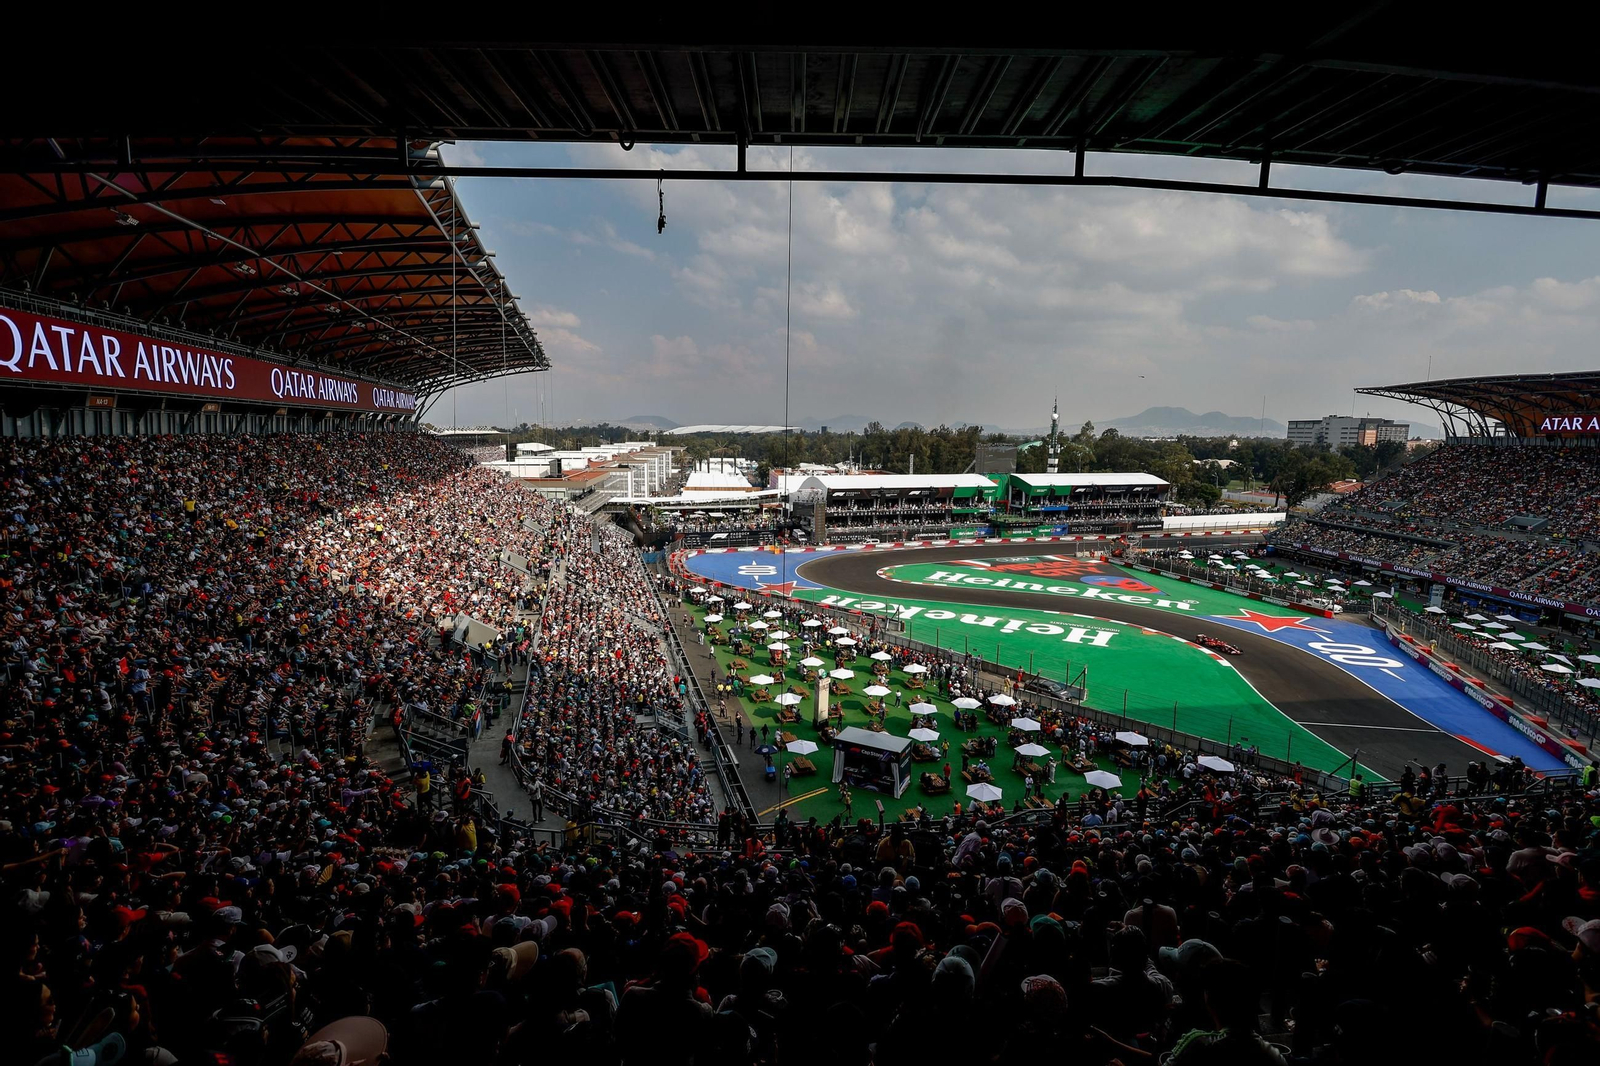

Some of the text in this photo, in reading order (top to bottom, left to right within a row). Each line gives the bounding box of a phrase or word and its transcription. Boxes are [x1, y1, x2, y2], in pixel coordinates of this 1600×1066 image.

[134, 341, 235, 390] AIRWAYS
[271, 368, 358, 404] QATAR AIRWAYS
[372, 387, 395, 408] QATAR
[1362, 558, 1382, 566] AIRWAYS
[1393, 565, 1432, 578] QATAR AIRWAYS
[927, 570, 1195, 611] Heineken
[1446, 577, 1492, 592] QATAR AIRWAYS
[1509, 592, 1565, 608] QATAR AIRWAYS
[820, 595, 1119, 647] Heineken
[1464, 686, 1494, 709] #MexicoGP
[1508, 716, 1546, 744] #MexicoGP
